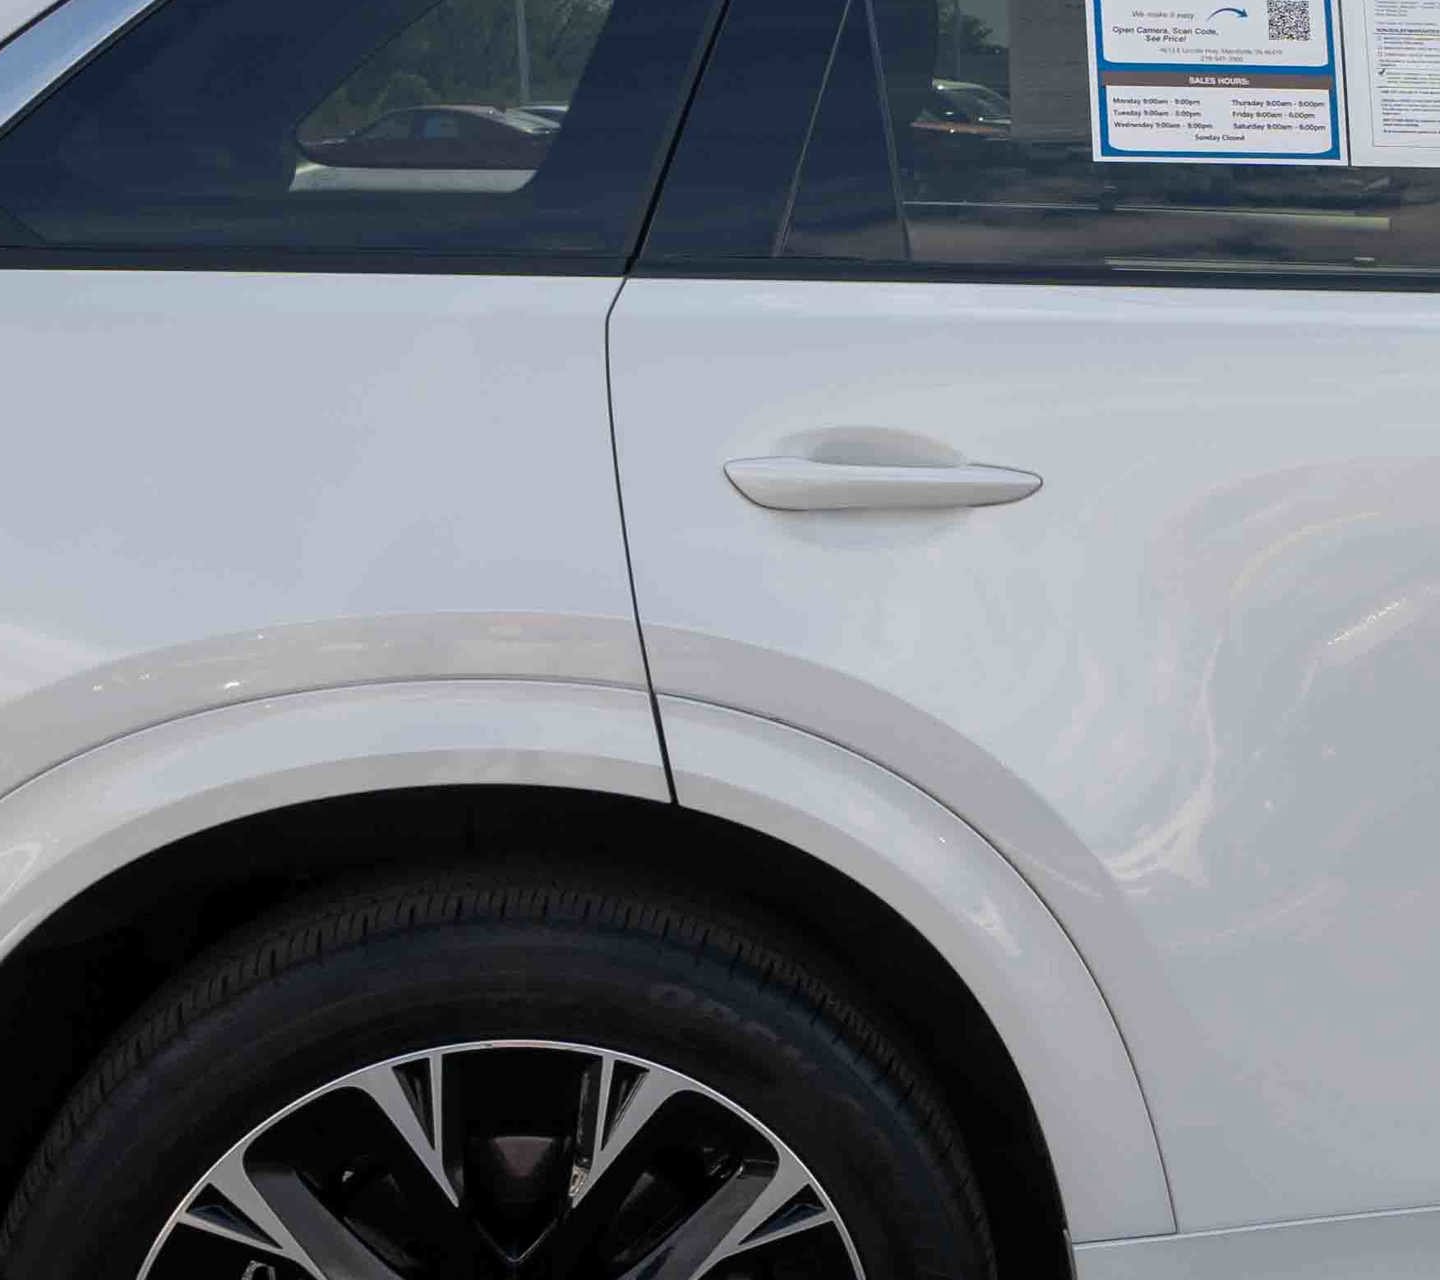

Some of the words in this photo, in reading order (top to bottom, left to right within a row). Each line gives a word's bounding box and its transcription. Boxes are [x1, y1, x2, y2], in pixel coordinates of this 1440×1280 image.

[1112, 26, 1134, 34] Open
[1113, 97, 1140, 105] Monday
[1114, 121, 1153, 129] Wednesday
